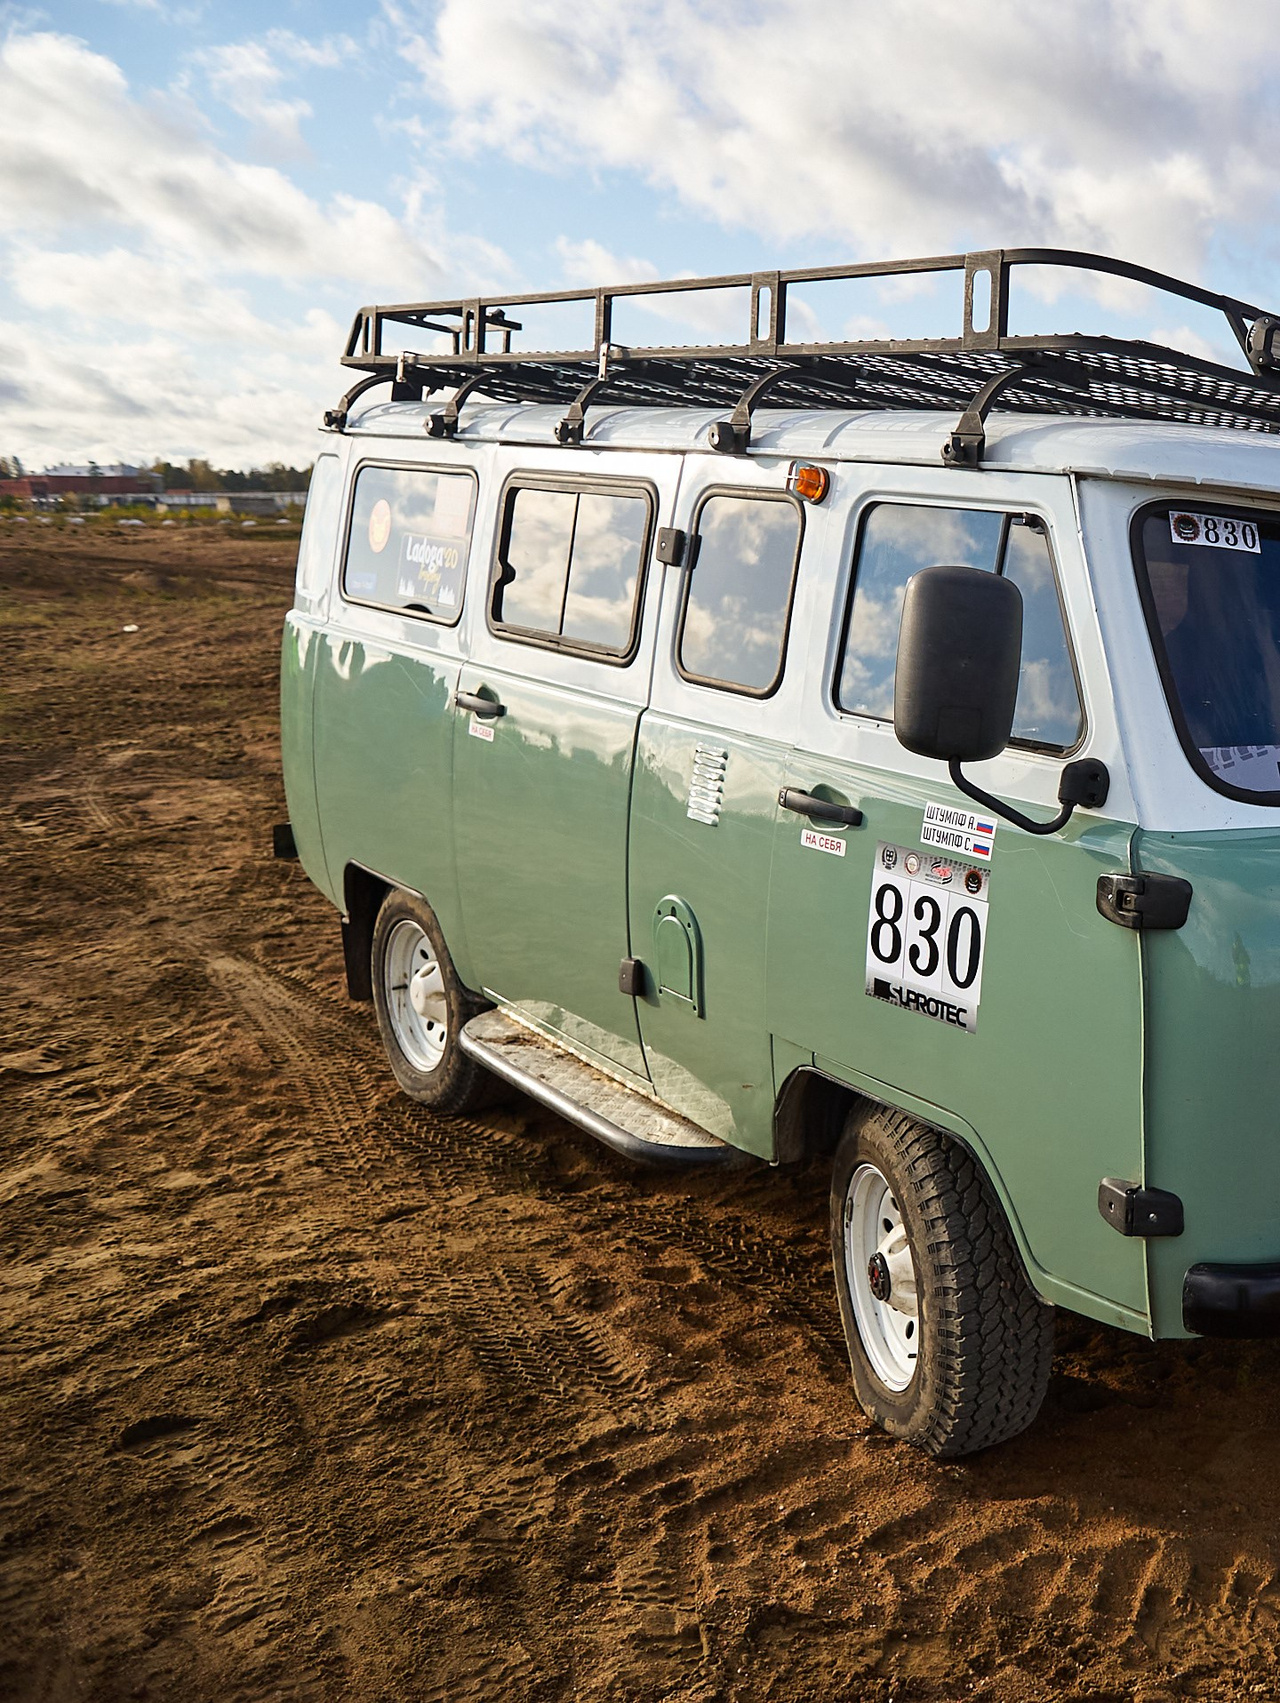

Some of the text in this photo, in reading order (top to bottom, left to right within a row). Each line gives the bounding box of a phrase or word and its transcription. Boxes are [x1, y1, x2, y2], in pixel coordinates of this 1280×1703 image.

[1204, 518, 1257, 549] 830
[926, 805, 967, 827] ШТУМПФ
[805, 833, 842, 852] НА СЕБЯ
[922, 826, 972, 852] ШТУМПФ С.
[870, 883, 982, 989] 830
[888, 983, 968, 1028] SUPROTEC
